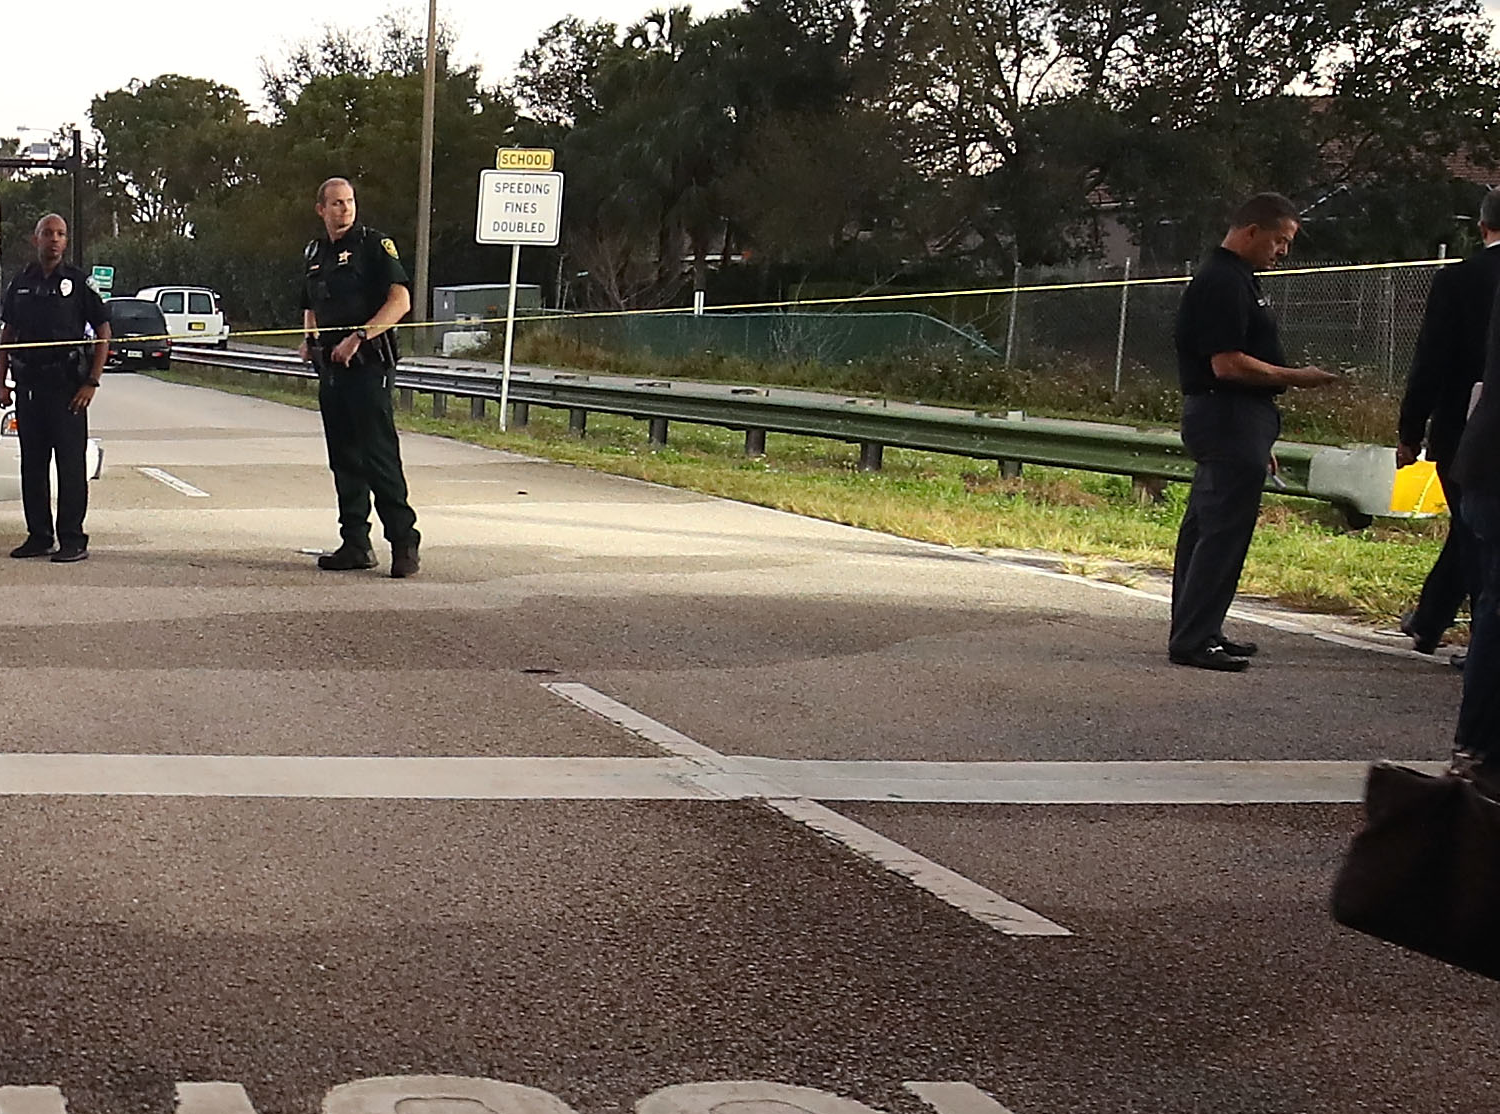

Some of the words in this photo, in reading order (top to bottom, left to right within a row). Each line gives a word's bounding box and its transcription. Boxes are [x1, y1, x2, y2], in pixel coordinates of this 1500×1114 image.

[501, 153, 550, 166] SCHOOL
[494, 182, 551, 195] SPEEDING
[504, 201, 538, 214] FINES
[492, 220, 546, 233] DOUBLED
